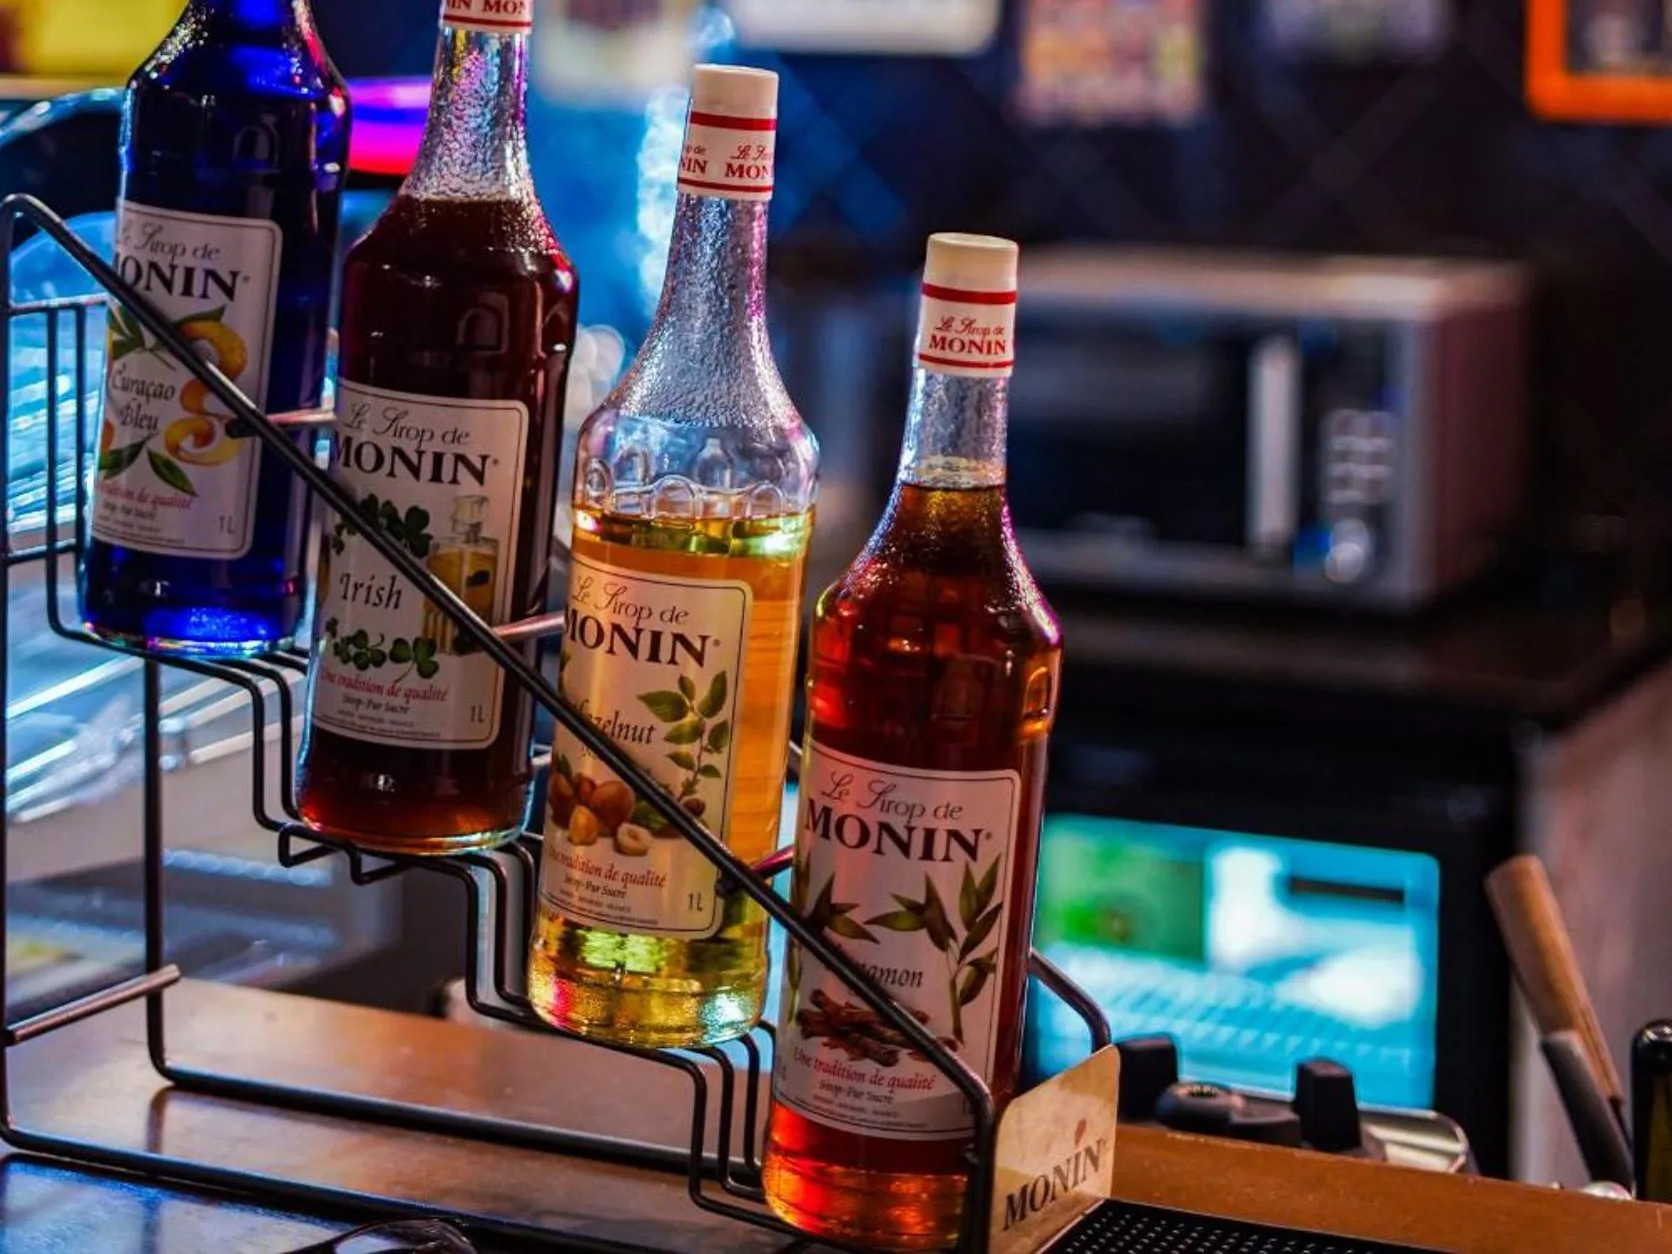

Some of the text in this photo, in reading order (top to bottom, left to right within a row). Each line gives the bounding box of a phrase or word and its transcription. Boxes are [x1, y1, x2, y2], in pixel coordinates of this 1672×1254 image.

[192, 242, 221, 260] de
[928, 333, 1006, 355] MONIN
[112, 362, 176, 404] Curaçao
[119, 397, 159, 431] Bleu
[372, 406, 434, 450] Sirop
[441, 426, 470, 446] de
[338, 571, 403, 611] Irish
[593, 582, 653, 627] Sirop
[660, 605, 690, 626] de
[820, 770, 964, 826] Le Sirop de
[804, 797, 984, 863] MONIN
[813, 1057, 867, 1083] tradition
[869, 1067, 888, 1088] de
[887, 1070, 936, 1094] qualité
[1002, 1138, 1105, 1232] MONIN
